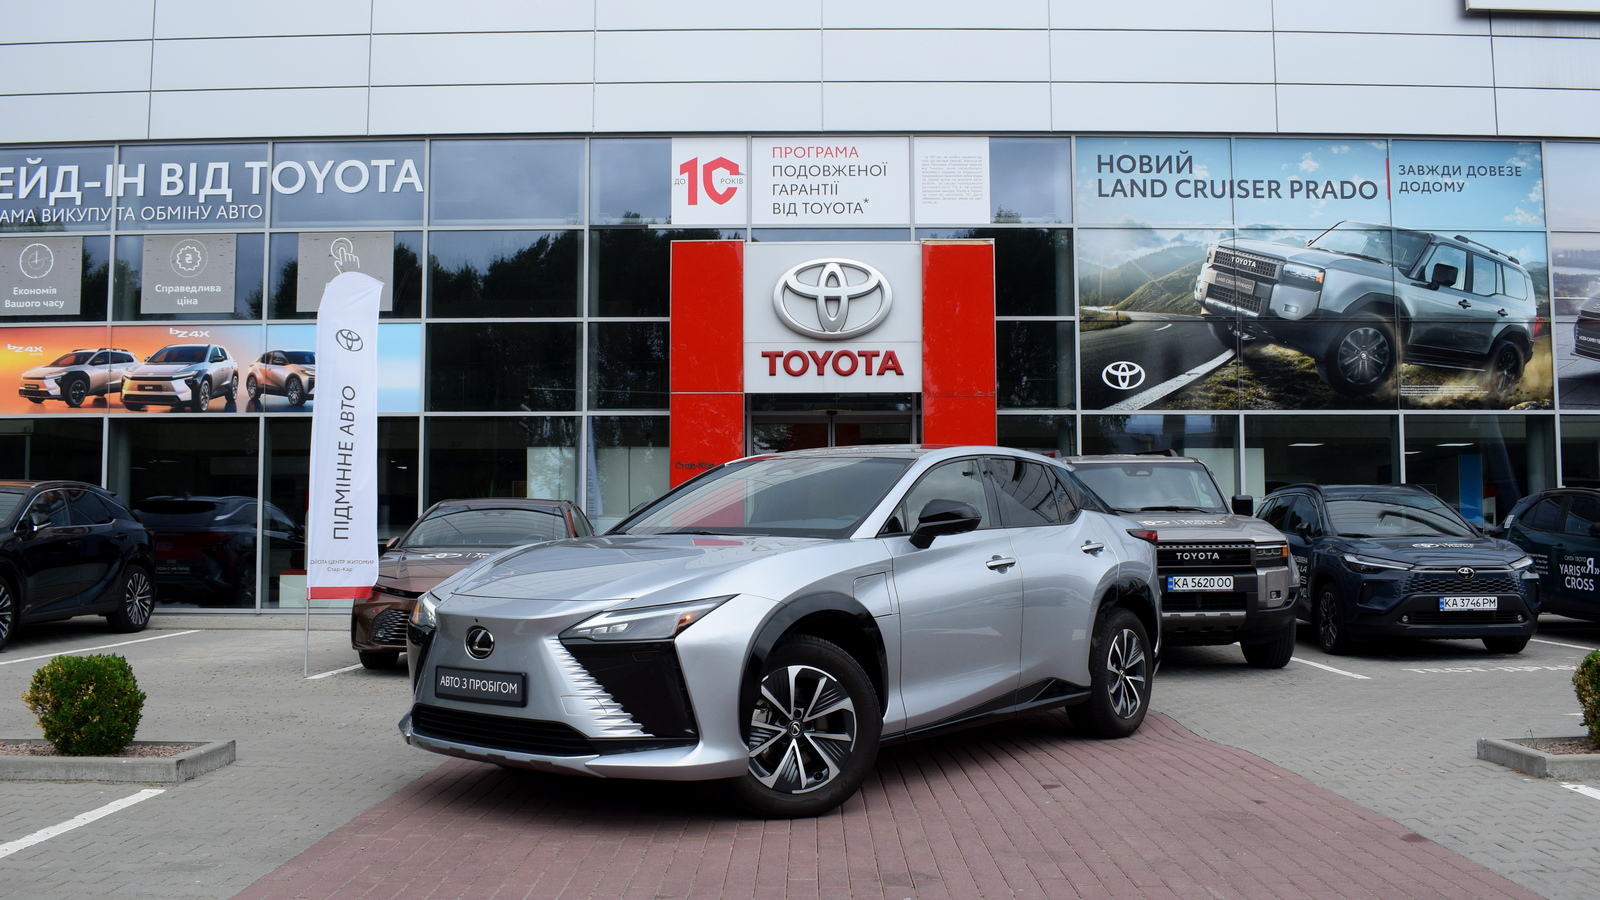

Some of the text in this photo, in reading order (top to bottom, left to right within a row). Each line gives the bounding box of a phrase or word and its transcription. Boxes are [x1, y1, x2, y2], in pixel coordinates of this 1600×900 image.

[771, 146, 860, 159] ПРОГРАМА
[1097, 150, 1194, 174] НОВИЙ
[771, 161, 888, 180] ПОДОВЖЕНОЇ
[1398, 164, 1523, 180] ЗАВЖДИ ДОВЕЗЕ
[160, 161, 233, 203] ВІД
[245, 158, 424, 195] TOYOTA
[674, 177, 686, 186] ДО
[720, 177, 744, 185] РОКІВ
[772, 181, 839, 197] ГАРАНТІЇ
[1097, 178, 1378, 200] LAND CRUISER PRADO
[1399, 181, 1466, 195] ДОДОМУ
[41, 207, 113, 223] ВИКУПУ
[116, 206, 136, 221] ТА
[140, 205, 213, 221] ОБМІНУ
[216, 204, 264, 220] АВТО
[772, 202, 798, 217] ВІД
[1231, 256, 1257, 268] TOYOTA
[12, 286, 57, 296] Економія
[155, 284, 222, 294] Справедлива
[4, 299, 65, 309] Вашого часу
[176, 296, 199, 306] ціна
[761, 350, 905, 377] TOYOTA
[333, 385, 356, 540] ПІДМІННЕ АВТО
[1176, 552, 1220, 560] TOYOTA
[1559, 563, 1581, 577] YARIS
[1191, 577, 1215, 588] 5620
[1564, 576, 1595, 592] CROSS
[1460, 598, 1481, 608] 3746
[1482, 598, 1496, 608] PM
[440, 675, 517, 694] АВТО З ПРОБІГОМ
